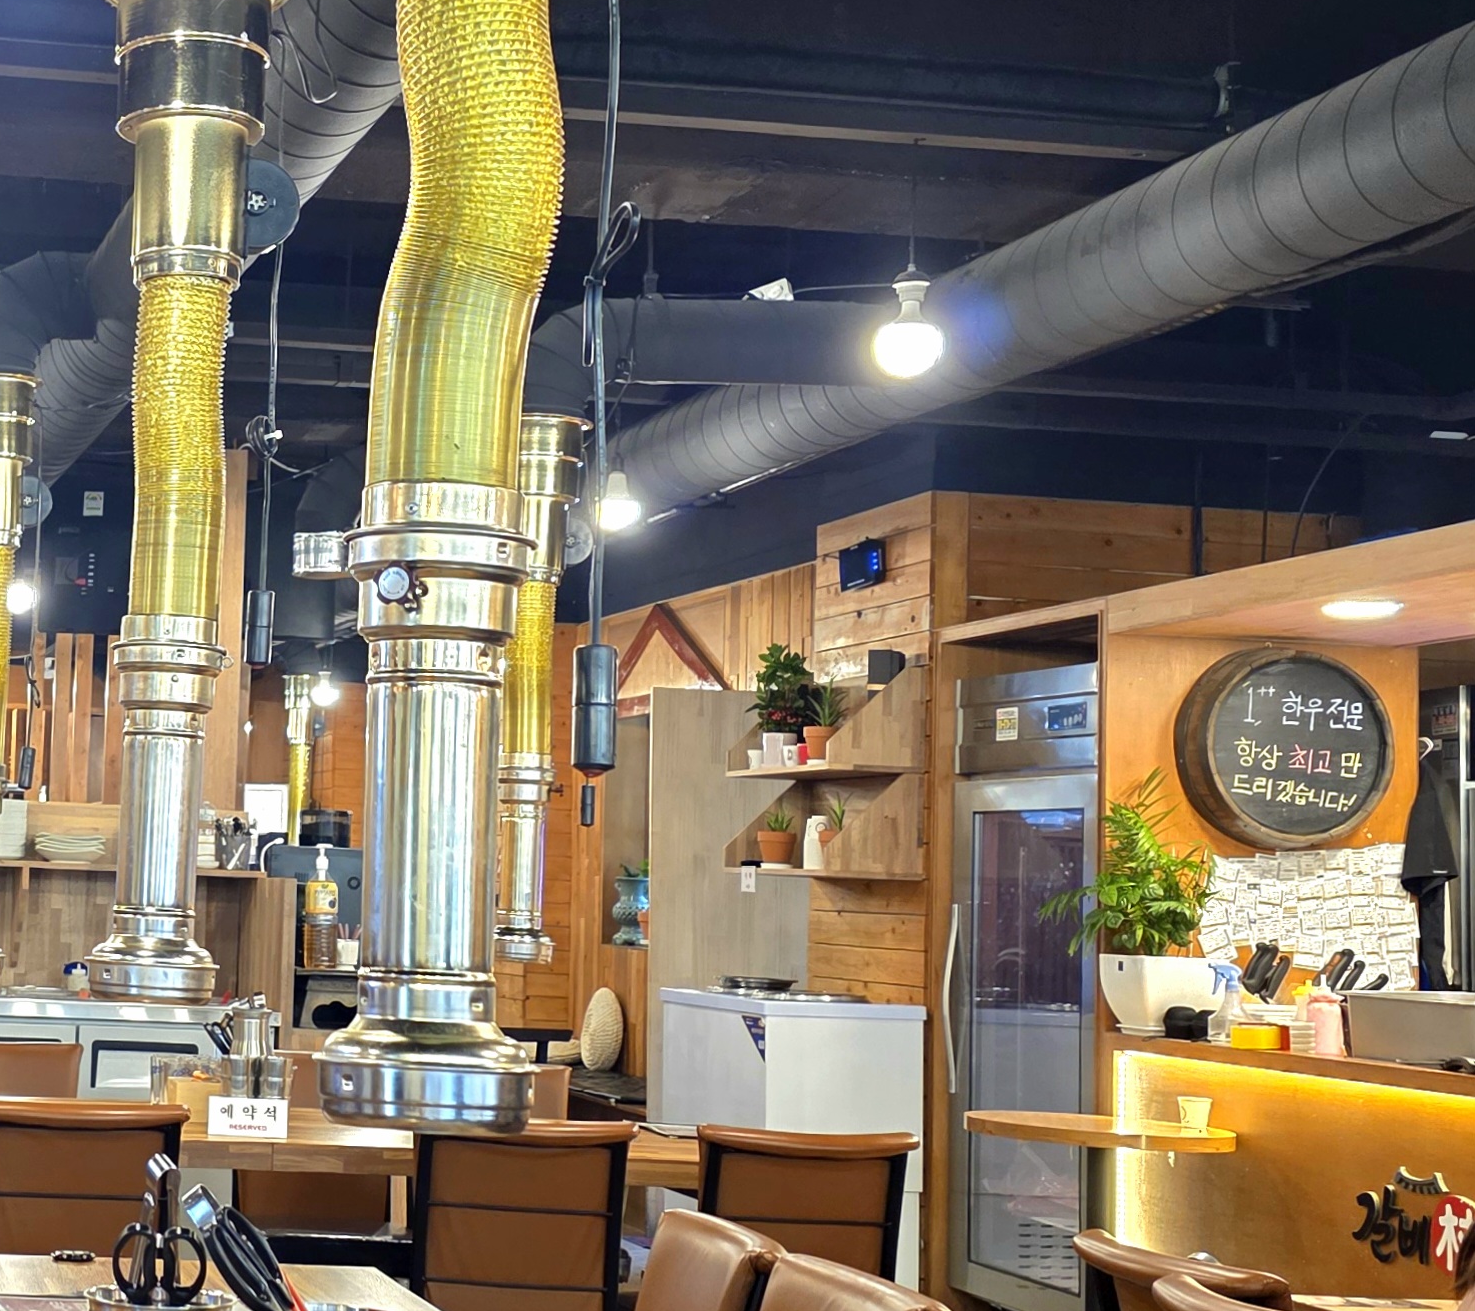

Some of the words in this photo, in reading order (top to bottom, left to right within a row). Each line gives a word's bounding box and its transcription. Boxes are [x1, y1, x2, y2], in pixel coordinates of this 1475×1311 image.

[1281, 690, 1324, 731] 한우
[1326, 697, 1364, 731] 전문
[1233, 736, 1283, 771] 항상
[1288, 744, 1332, 774] 최고
[1340, 751, 1363, 779] 만
[1231, 774, 1358, 813] 드리겠습니다!
[229, 1123, 267, 1132] RESERVED
